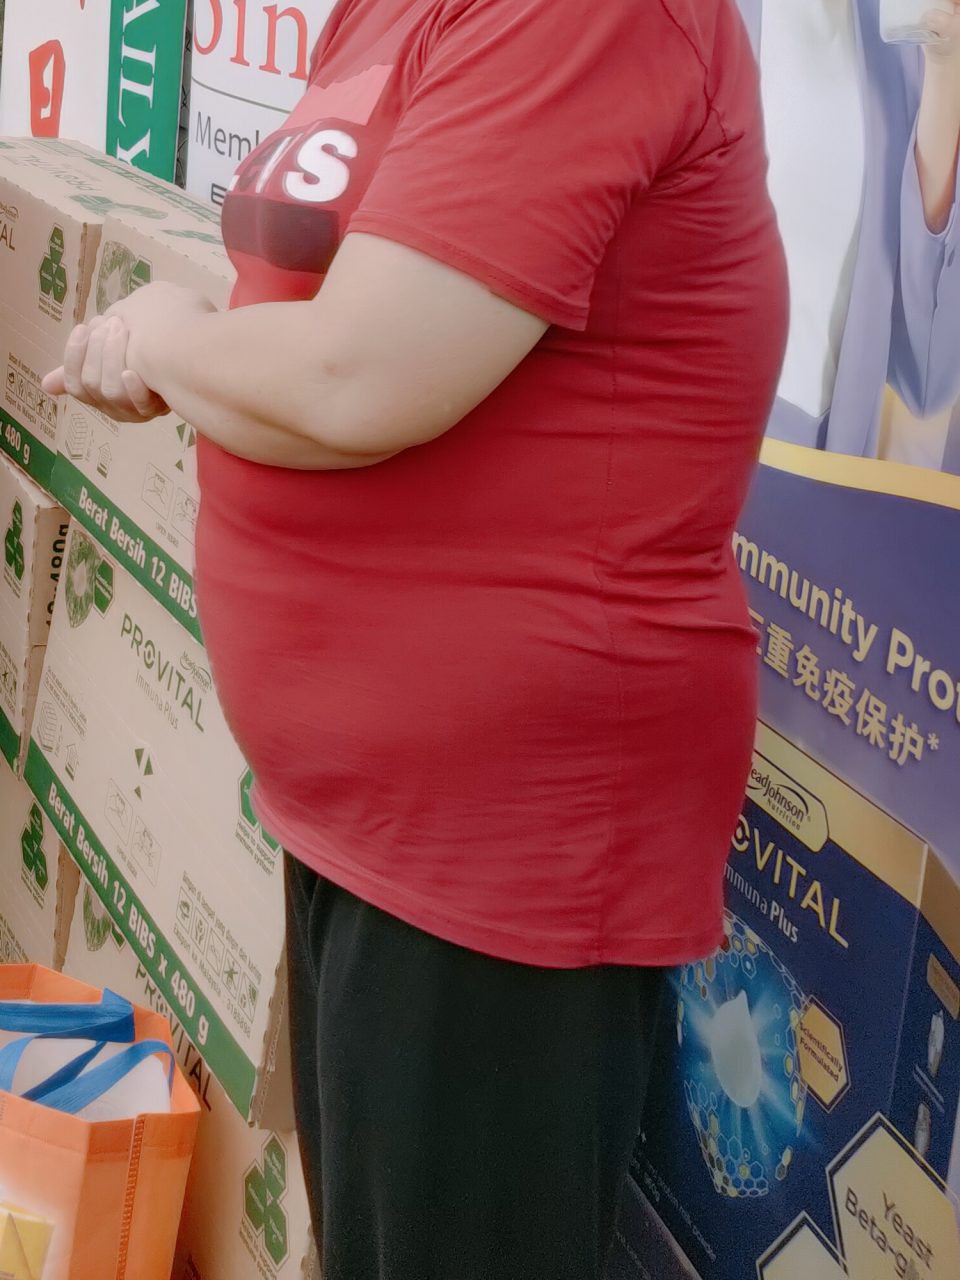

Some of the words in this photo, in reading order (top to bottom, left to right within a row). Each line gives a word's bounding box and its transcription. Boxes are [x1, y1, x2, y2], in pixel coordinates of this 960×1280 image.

[4, 423, 22, 451] 480
[23, 443, 31, 465] g
[78, 485, 108, 533] Berat
[109, 513, 147, 570] Bersih
[150, 554, 166, 588] 12
[167, 575, 198, 619] BIBS
[120, 611, 205, 733] PROVITAL
[135, 668, 163, 712] Immuna
[163, 700, 179, 730] Plus
[766, 797, 801, 831] Nutrition
[48, 781, 76, 838] Berat
[76, 821, 110, 889] Bersih
[113, 879, 128, 915] 12
[128, 908, 157, 959] BIBS
[158, 952, 168, 979] x
[170, 969, 196, 1018] 480
[197, 1013, 209, 1046] g
[769, 900, 799, 944] Plus
[882, 1190, 934, 1271] Yeast
